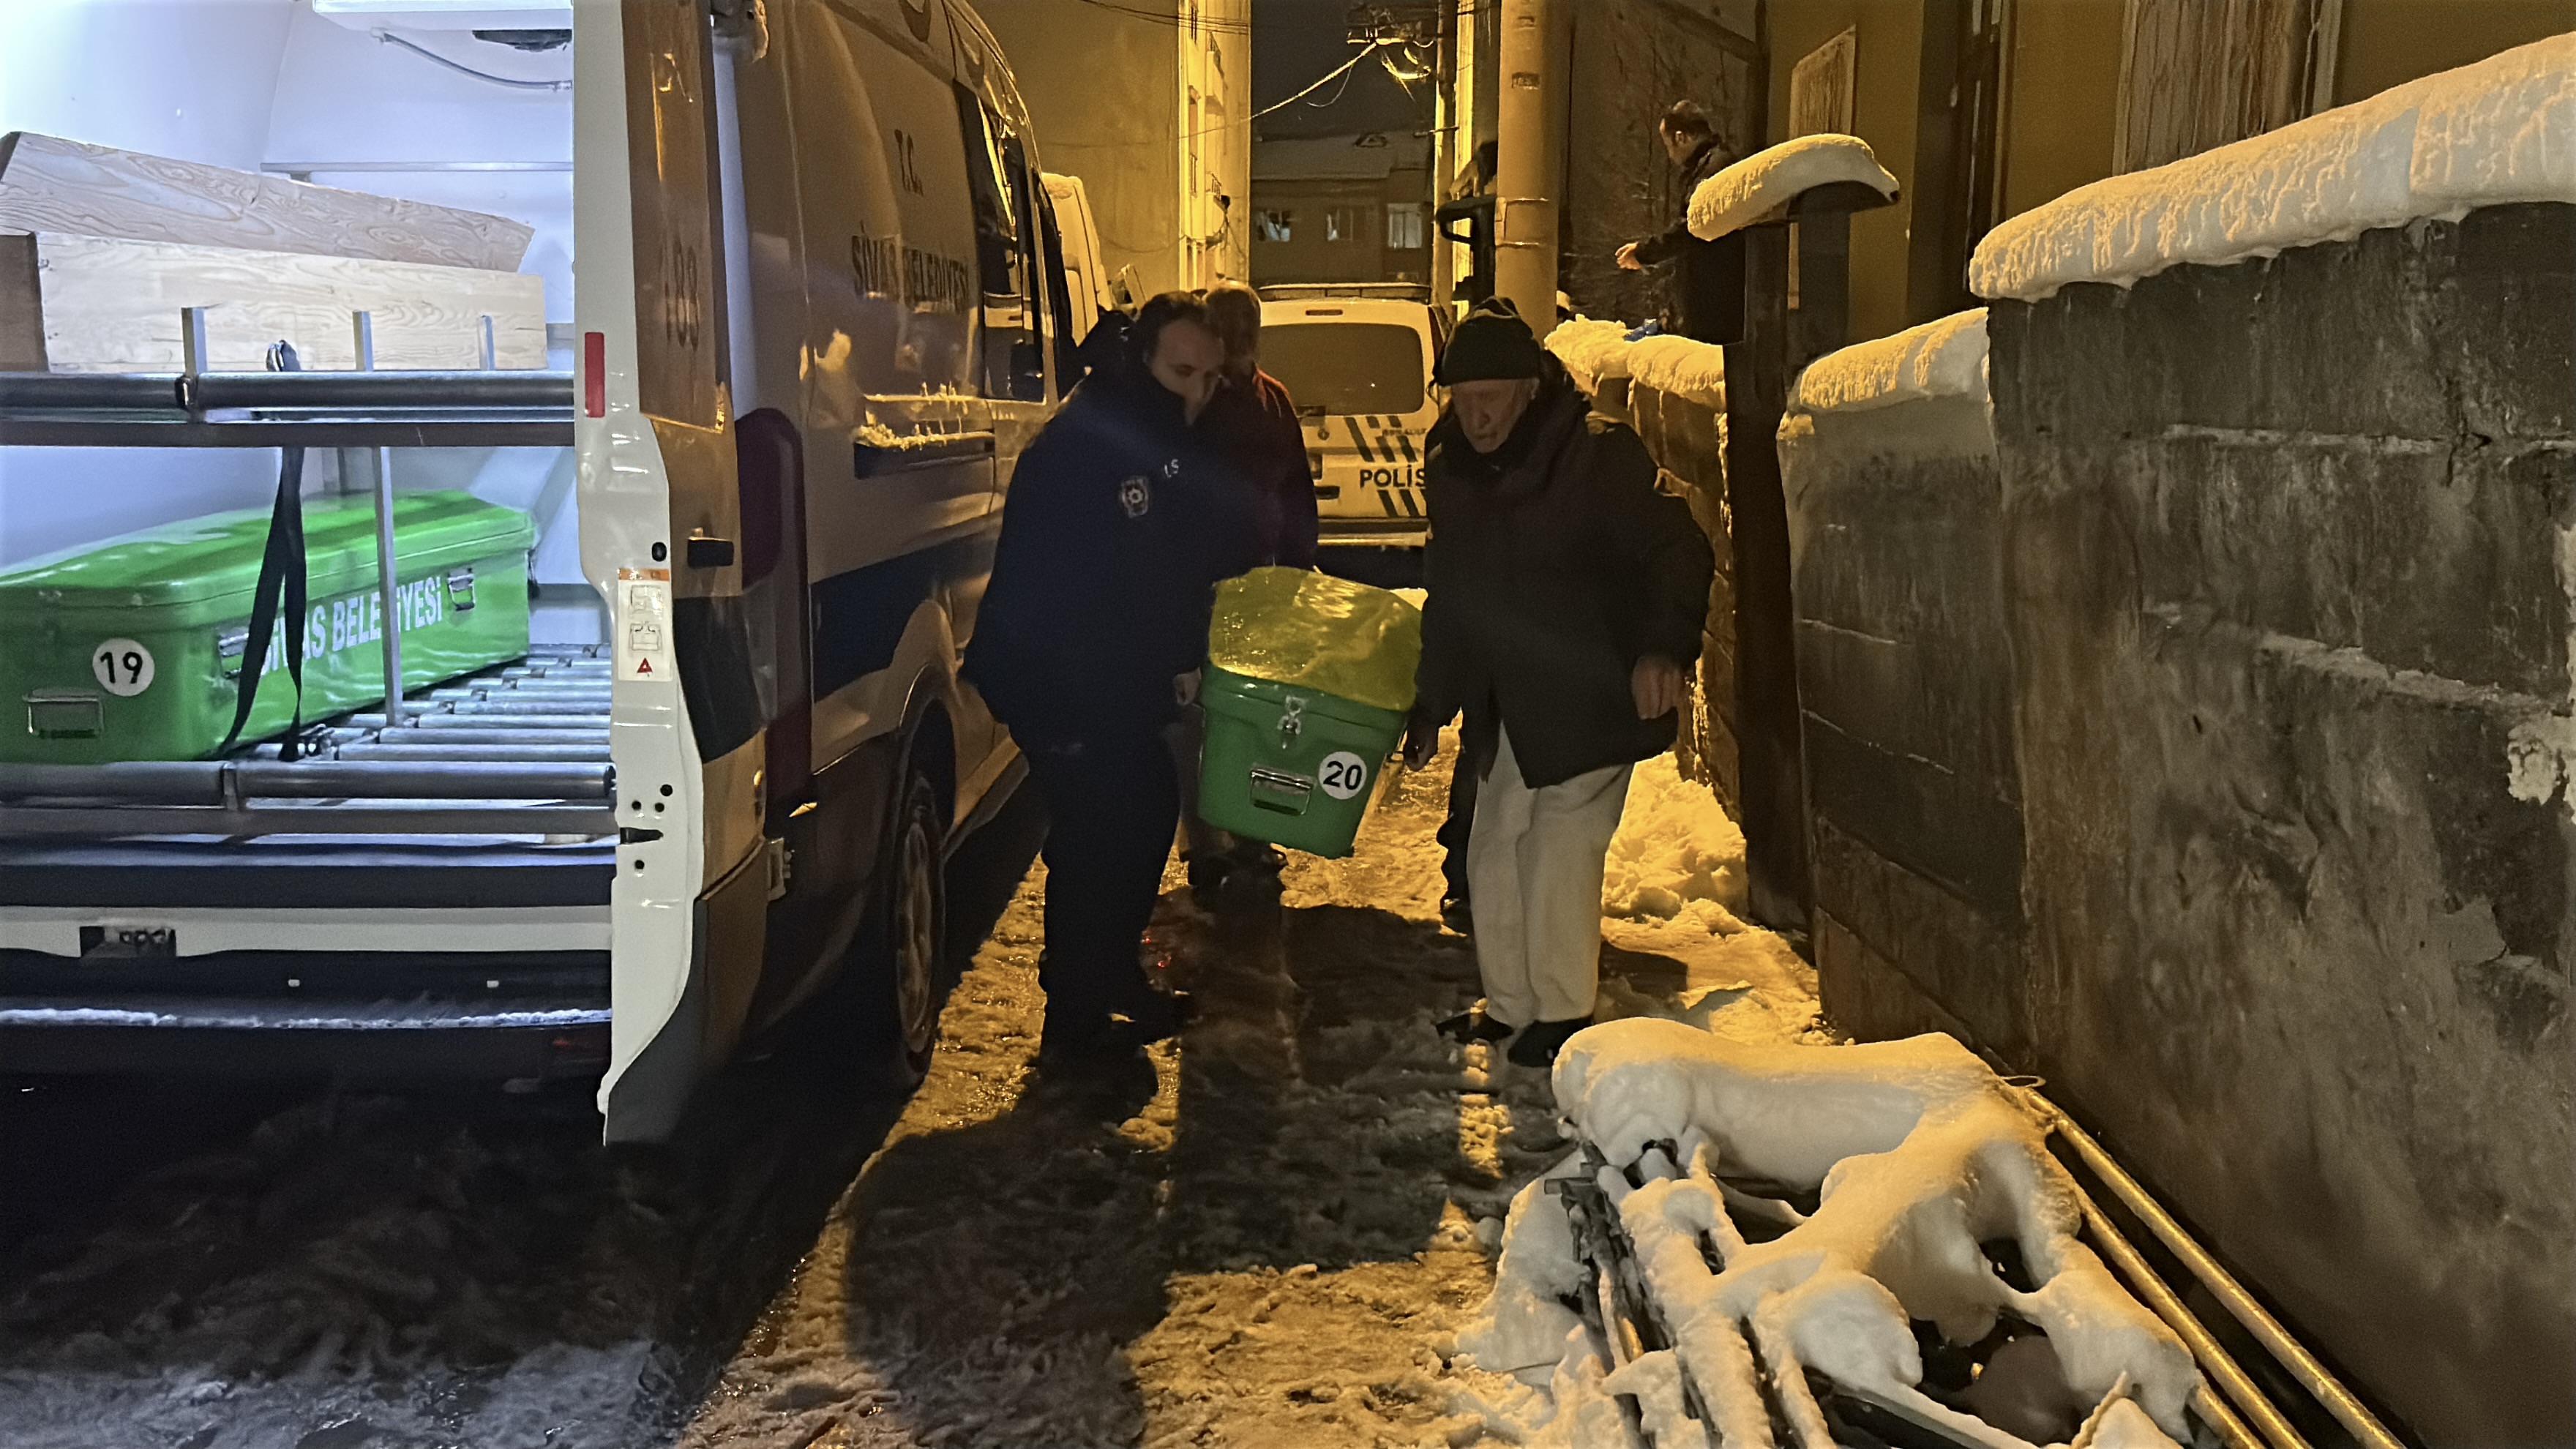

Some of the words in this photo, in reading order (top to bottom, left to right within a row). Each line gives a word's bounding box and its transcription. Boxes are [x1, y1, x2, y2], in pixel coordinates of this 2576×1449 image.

[1360, 464, 1425, 489] POLİS
[332, 575, 443, 651] BELEİYESİ
[100, 651, 143, 684] 19
[1322, 760, 1362, 790] 20
